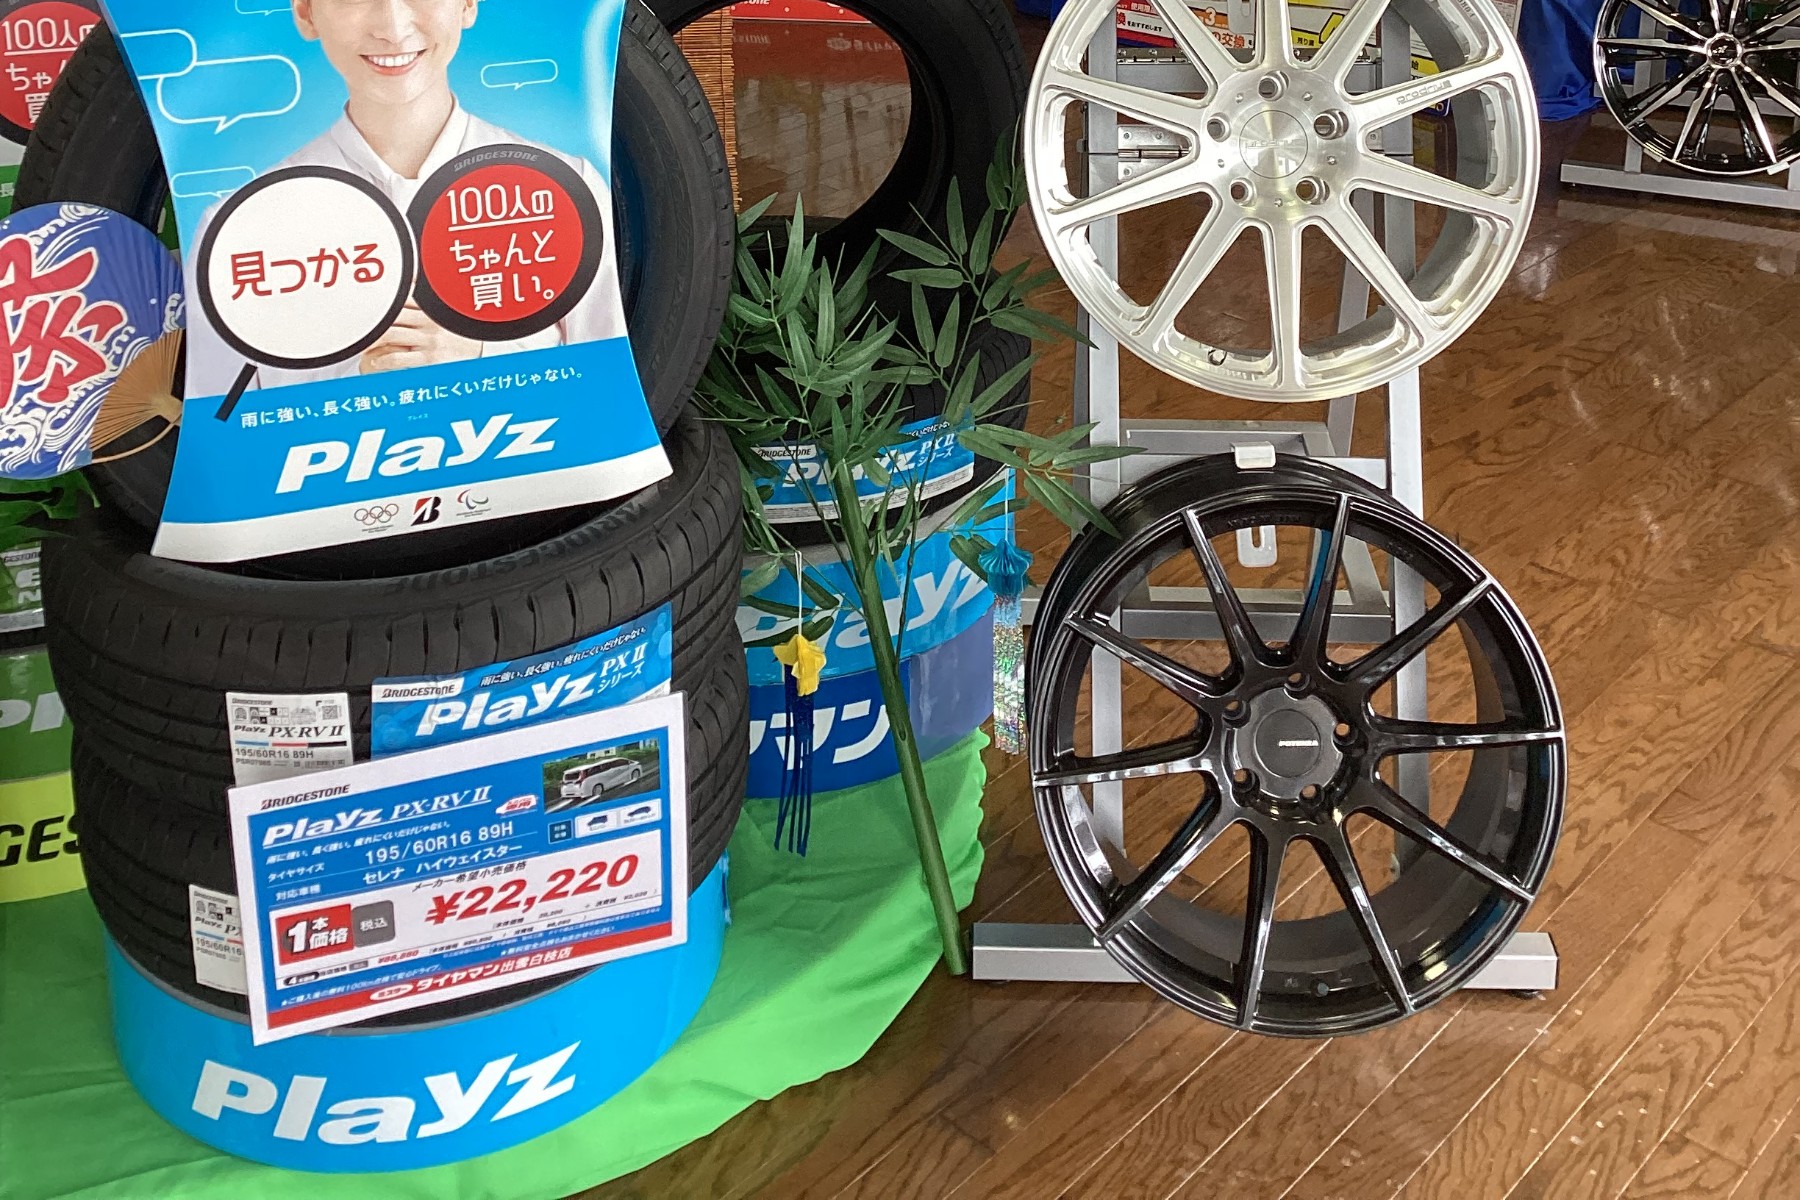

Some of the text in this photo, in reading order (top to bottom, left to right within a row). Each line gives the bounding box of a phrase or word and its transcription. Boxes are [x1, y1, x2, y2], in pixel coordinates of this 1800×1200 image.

[5, 59, 68, 92] ちゃ
[453, 149, 540, 172] BRIDGESTONE
[446, 183, 555, 226] 100人の
[230, 242, 386, 301] 見つかる
[449, 229, 557, 274] ちゃんと
[470, 272, 555, 311] 買い。
[275, 412, 560, 495] Playz
[597, 663, 646, 694] シリーズ
[600, 652, 629, 678] PX
[381, 683, 456, 699] BRIDGESTONE
[414, 671, 598, 737] Playz
[234, 724, 267, 734] Playz
[268, 725, 328, 739] PX-RV
[235, 748, 290, 759] 195/60R16
[260, 783, 351, 811] BRIDGESTONE
[262, 806, 384, 847] Playz
[390, 788, 470, 821] PX-RV
[268, 821, 514, 883] タイヤサイズ 195/60R16 89H
[362, 866, 406, 886] セレナ
[416, 845, 523, 874] ハイウェイスター
[424, 853, 639, 926] ¥22,220
[191, 1040, 582, 1146] Playz
